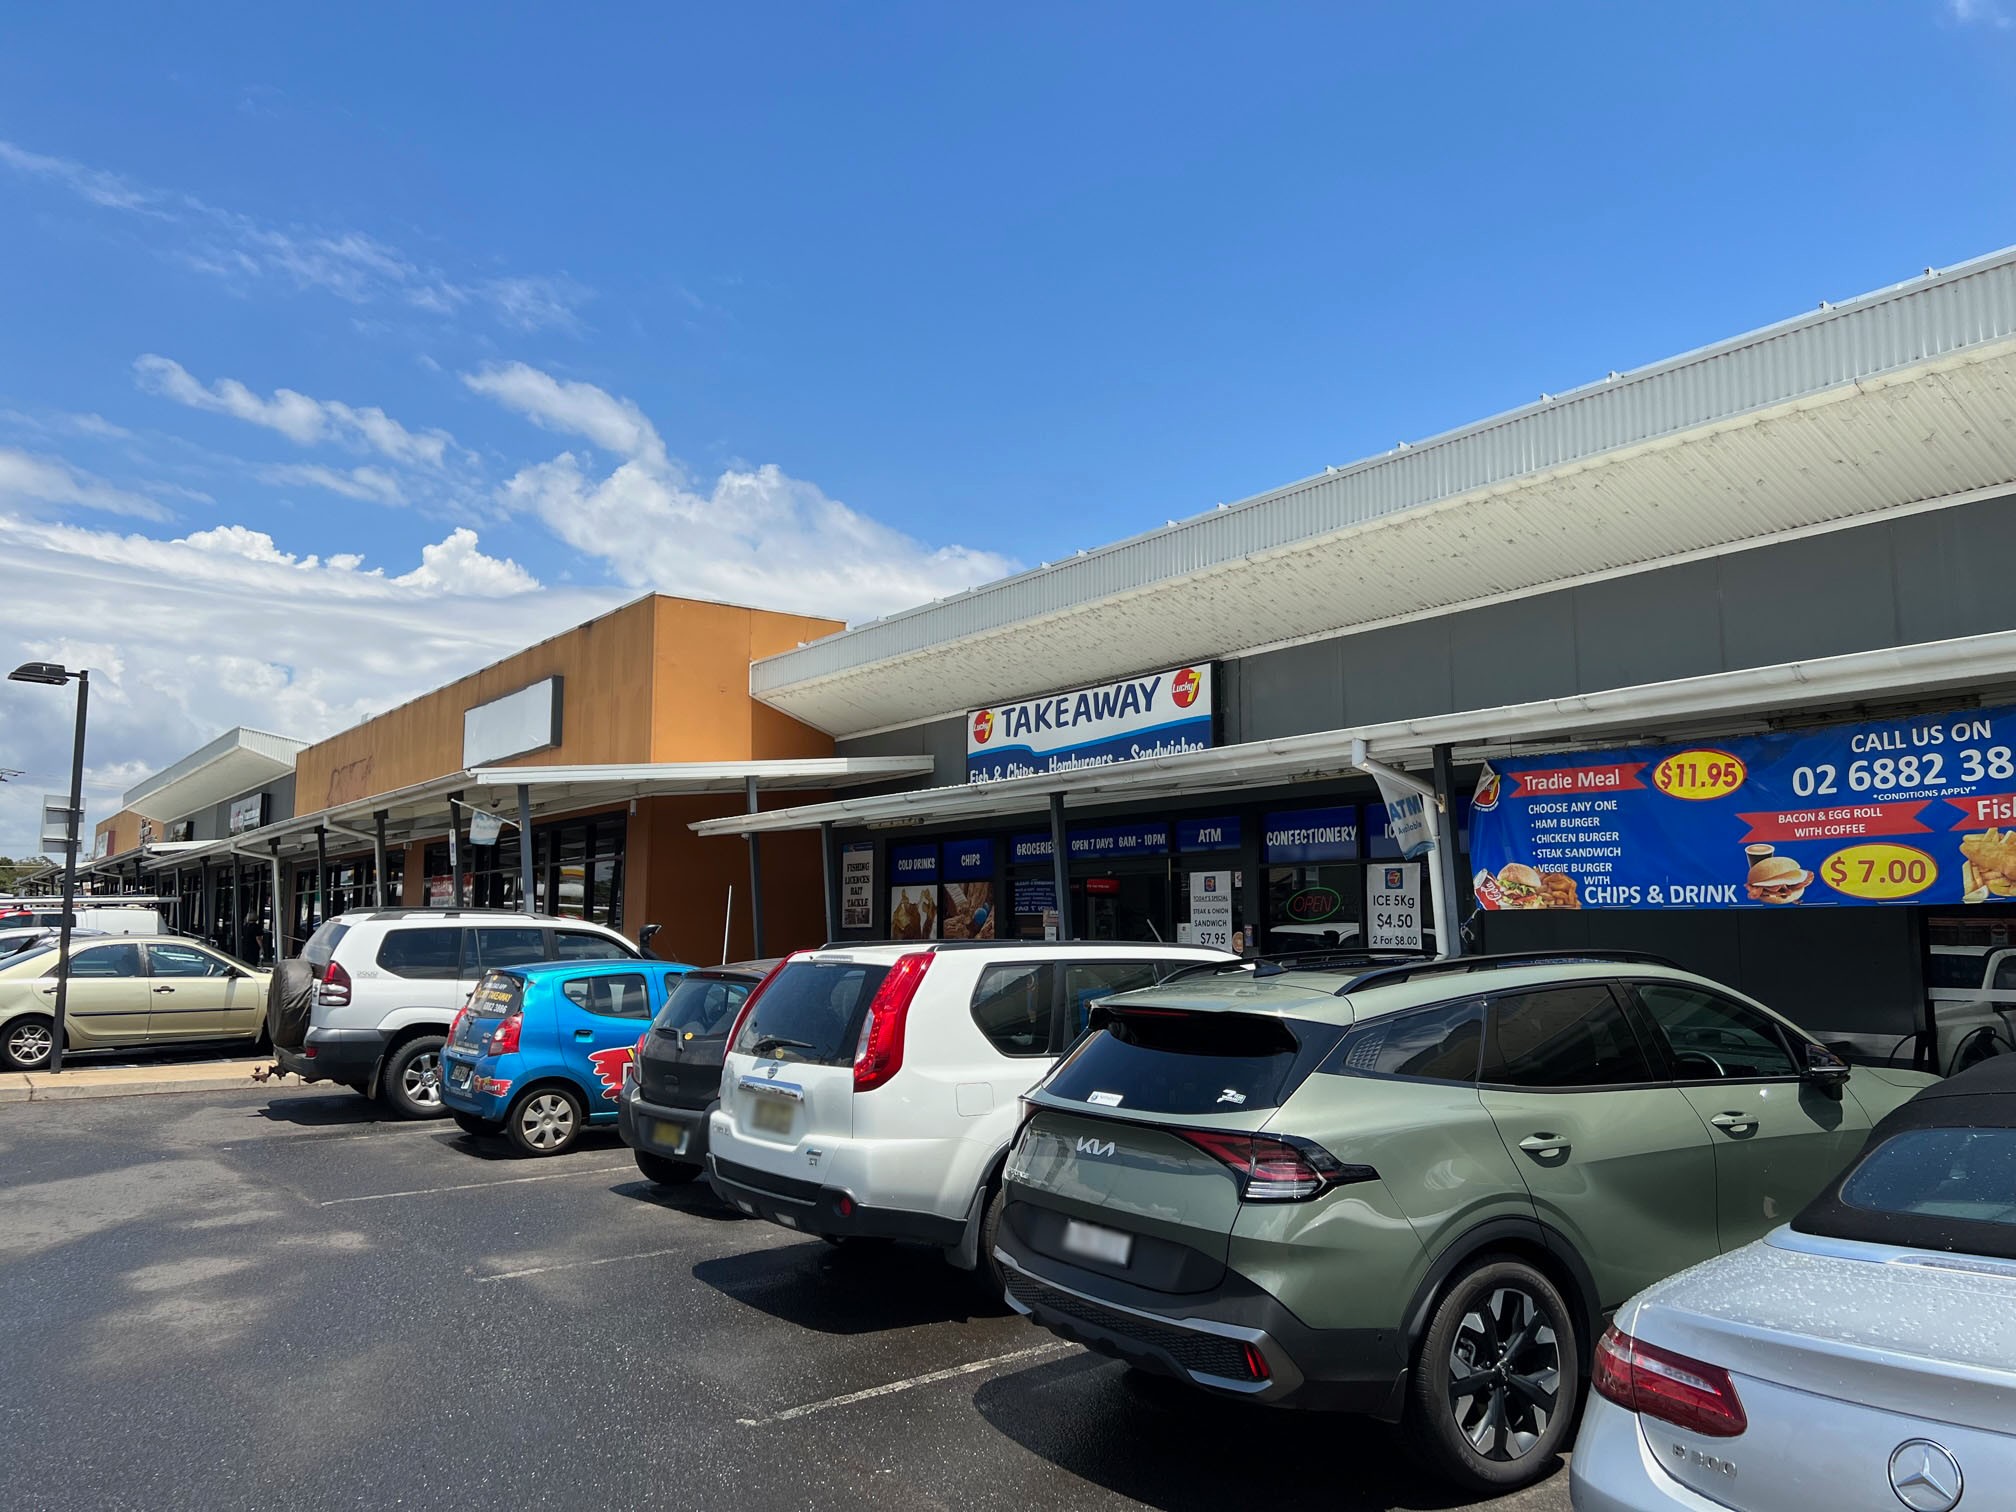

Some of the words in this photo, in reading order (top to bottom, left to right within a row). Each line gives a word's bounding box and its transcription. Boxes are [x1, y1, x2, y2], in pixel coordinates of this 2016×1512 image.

[1172, 682, 1194, 695] Lucky
[1187, 671, 1202, 702] 7
[1001, 676, 1162, 738] TAKEAWAY
[973, 721, 992, 733] Lucky
[985, 714, 994, 739] 7
[1851, 730, 1906, 753] CALL
[1911, 725, 1944, 746] US
[1951, 720, 1991, 742] ON
[970, 768, 988, 783] Fish
[994, 766, 1002, 781] &
[1660, 761, 1738, 789] $11.95
[1792, 764, 1837, 797] 02
[1848, 752, 1947, 792] 6882
[1959, 745, 2015, 782] 38
[1524, 772, 1572, 791] Tradie
[1577, 769, 1620, 787] Meal
[1388, 795, 1422, 822] ATM
[1528, 802, 1569, 815] CHOOSE
[1570, 801, 1592, 812] ANY
[1594, 800, 1617, 811] ONE
[1778, 812, 1815, 824] BACON
[1817, 811, 1827, 821] &
[1828, 809, 1851, 821] EGG
[1853, 807, 1882, 818] ROLL
[1384, 823, 1395, 839] IC
[1535, 818, 1557, 829] HAM
[1560, 817, 1600, 828] BURGER
[1794, 827, 1822, 838] WITH
[1824, 823, 1866, 836] COFFEE
[1071, 840, 1088, 851] OPEN
[1090, 839, 1095, 850] 7
[1096, 838, 1114, 849] DAYS
[1118, 836, 1136, 848] 6AM
[1144, 833, 1166, 846] 10PM
[1198, 828, 1222, 843] ATM
[1266, 825, 1357, 846] CONFECTIONERY
[1536, 832, 1576, 844] CHICKEN
[1578, 831, 1619, 843] BURGER
[961, 853, 980, 866] CHIPS
[1537, 848, 1563, 859] STEAK
[1565, 847, 1621, 858] SANDWICH
[847, 862, 870, 873] FISHING
[898, 859, 913, 870] COLD
[913, 858, 935, 870] DRINKS
[1538, 863, 1568, 873] VEGGIE
[1571, 862, 1613, 873] BURGER
[1583, 875, 1610, 885] WITH
[850, 886, 863, 896] BAIT
[1584, 885, 1641, 904] CHIPS
[1647, 885, 1664, 904] &
[1669, 884, 1738, 904] DRINK
[1293, 895, 1333, 913] OPEN
[1373, 895, 1391, 906] ICE
[1394, 895, 1415, 909] 5Kg
[1377, 912, 1413, 930] $4.50
[1200, 932, 1226, 945] $7.95
[1372, 936, 1378, 945] 2
[1380, 936, 1393, 945] For
[1394, 935, 1417, 946] $8.00
[1075, 1136, 1116, 1158] KIA
